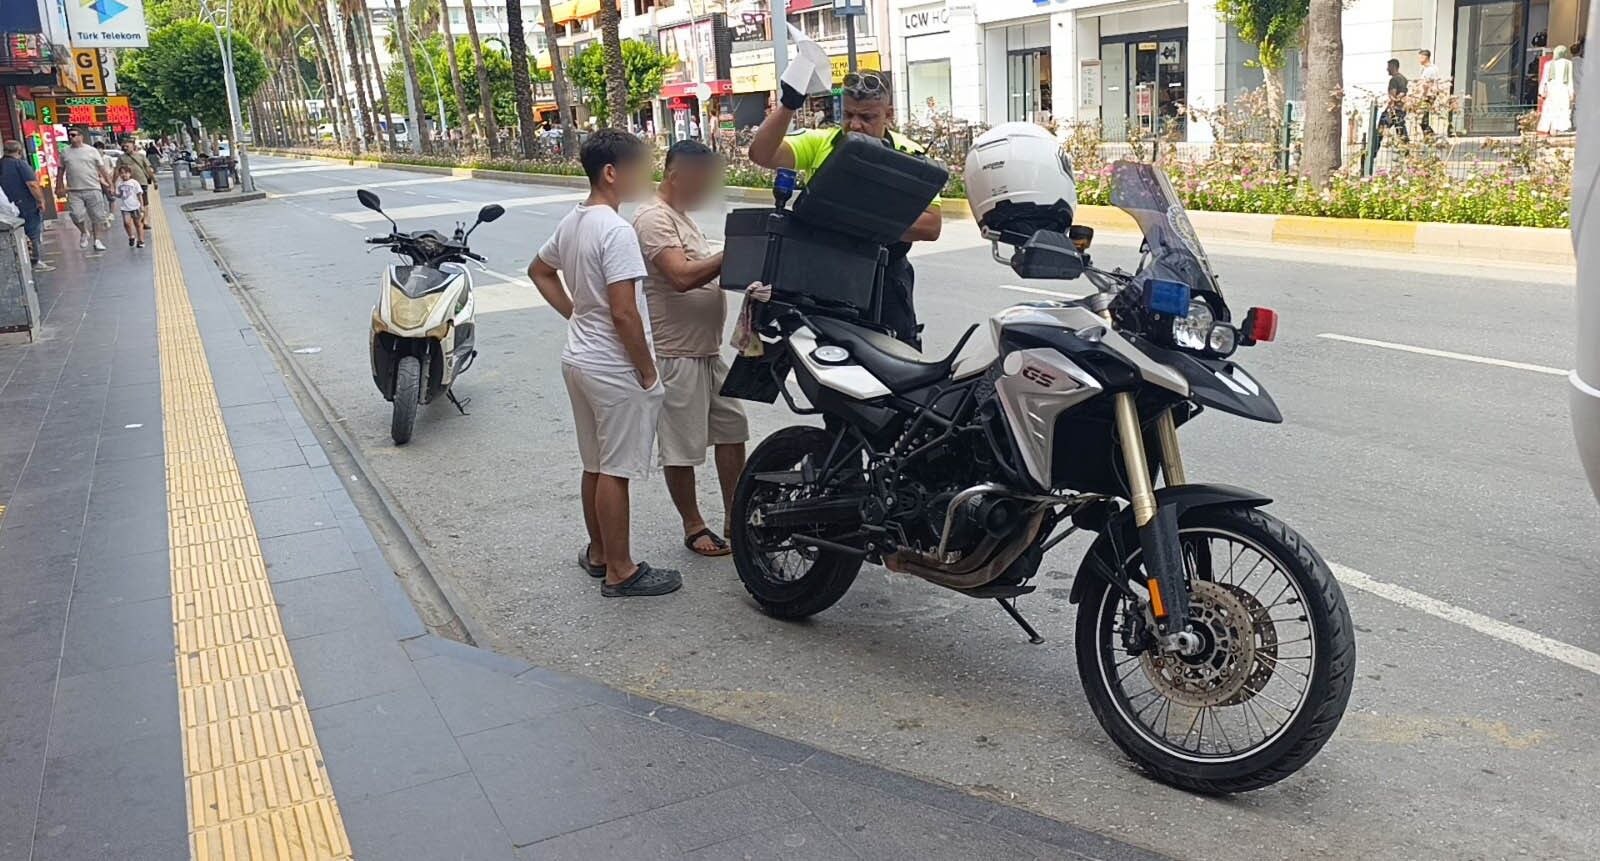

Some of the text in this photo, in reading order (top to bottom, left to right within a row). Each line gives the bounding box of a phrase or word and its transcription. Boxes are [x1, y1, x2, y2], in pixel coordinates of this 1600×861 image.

[905, 12, 928, 28] LCW
[77, 31, 141, 40] Türk Telekom
[65, 97, 101, 105] CHANGE
[1023, 366, 1056, 388] GS
